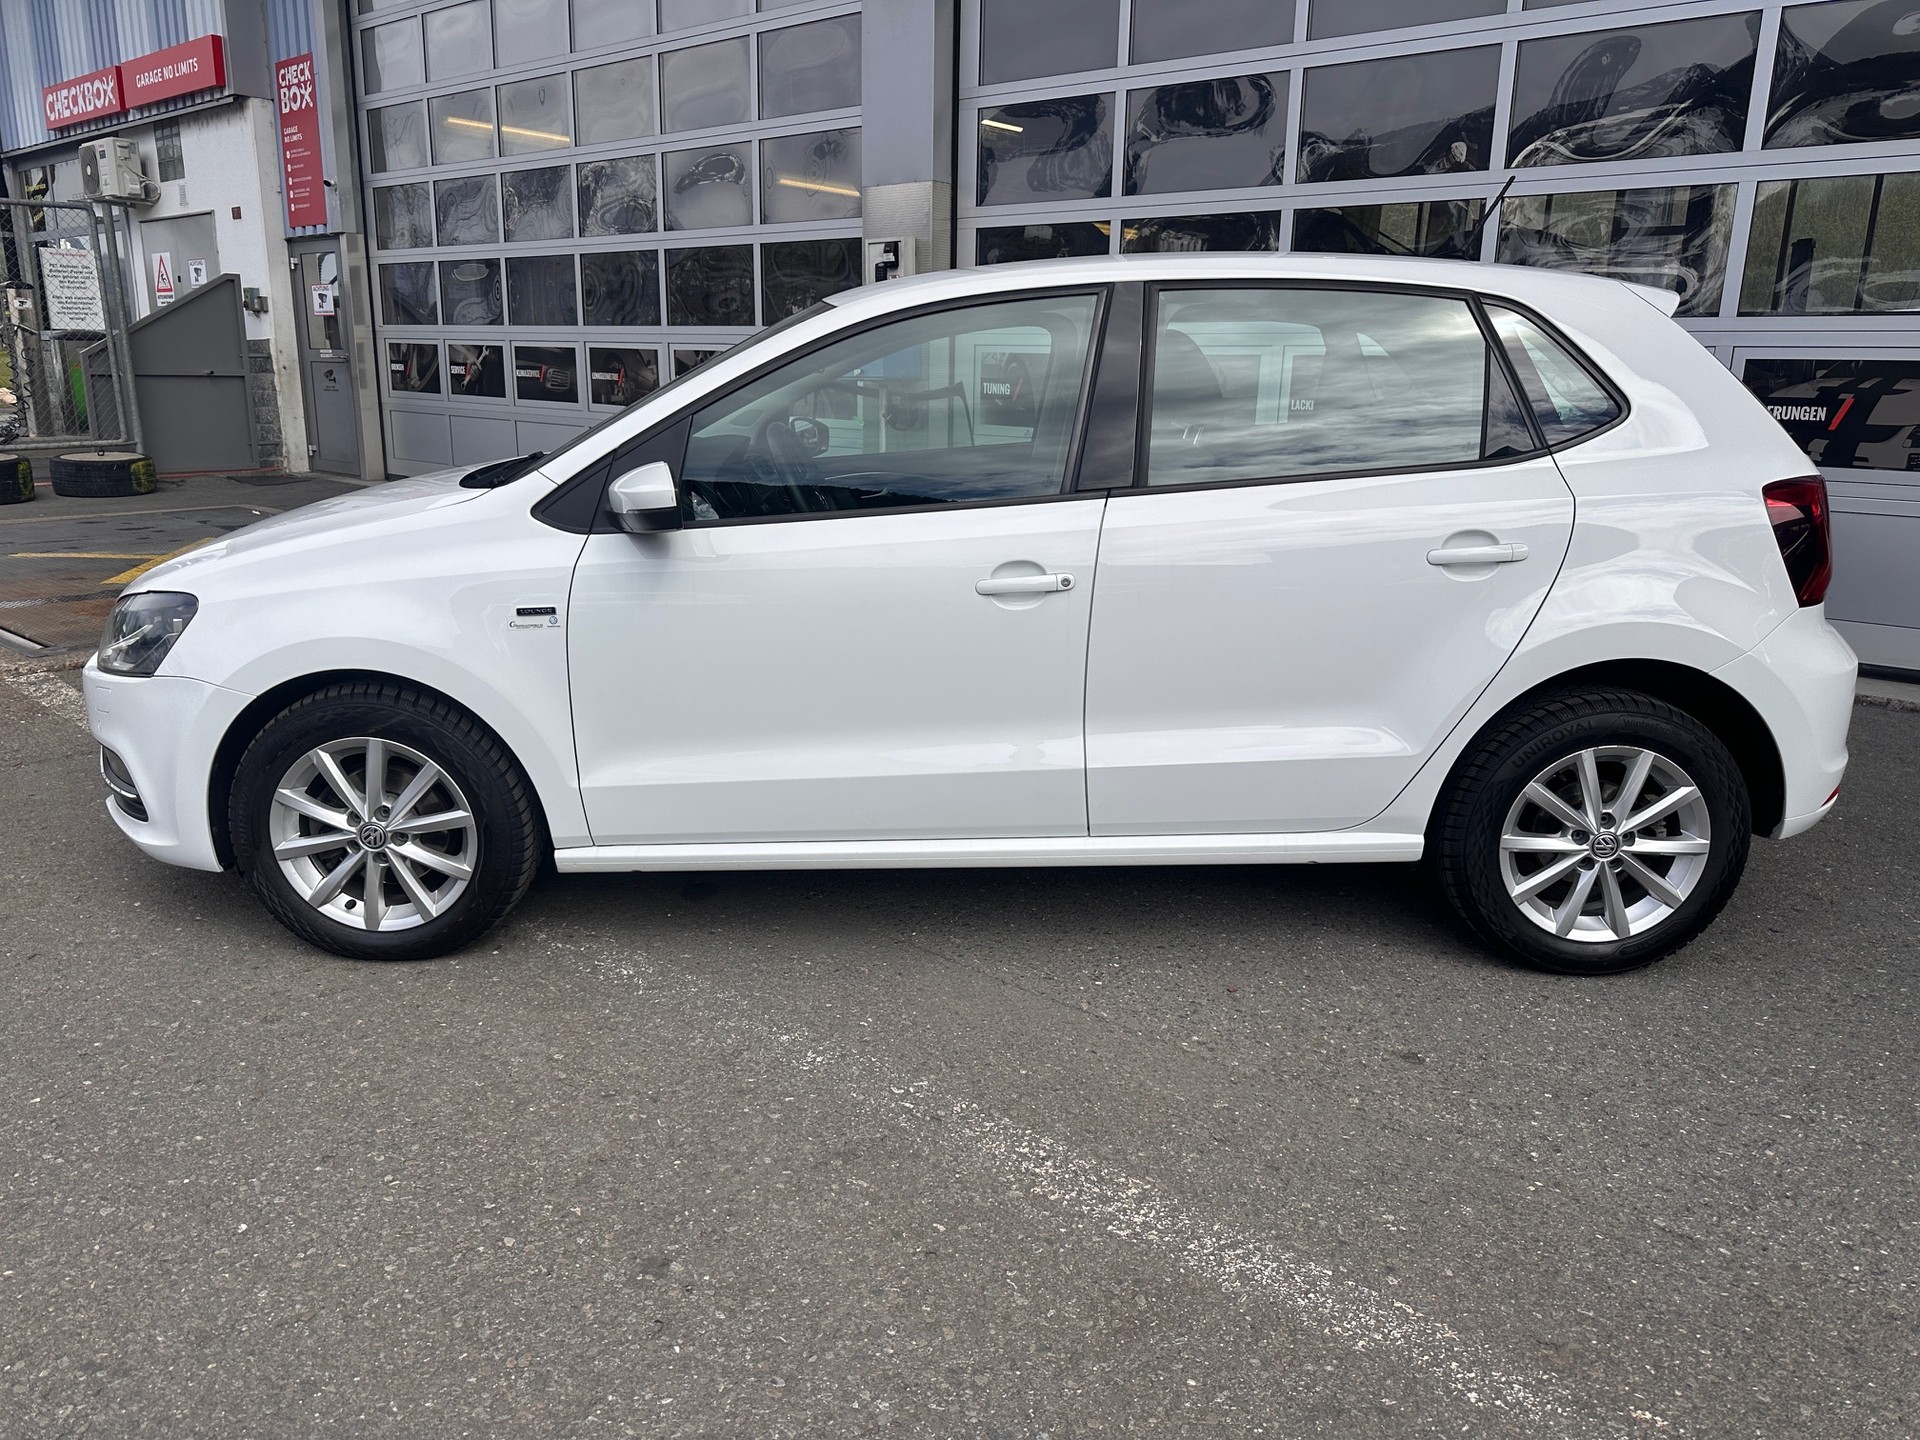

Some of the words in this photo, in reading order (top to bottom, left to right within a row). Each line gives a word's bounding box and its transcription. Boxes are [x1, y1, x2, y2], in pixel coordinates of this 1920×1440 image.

[136, 69, 163, 89] GARAGE
[163, 65, 173, 80] NO
[174, 57, 198, 77] LIMITS
[279, 60, 311, 87] CHECK
[46, 75, 116, 122] CHECKBOX
[280, 81, 313, 114] BOX
[283, 125, 298, 135] GARAGE
[284, 135, 290, 143] NO
[290, 133, 303, 142] LIMITS
[983, 382, 1011, 395] TUNING
[1512, 718, 1596, 769] UNIROYAL
